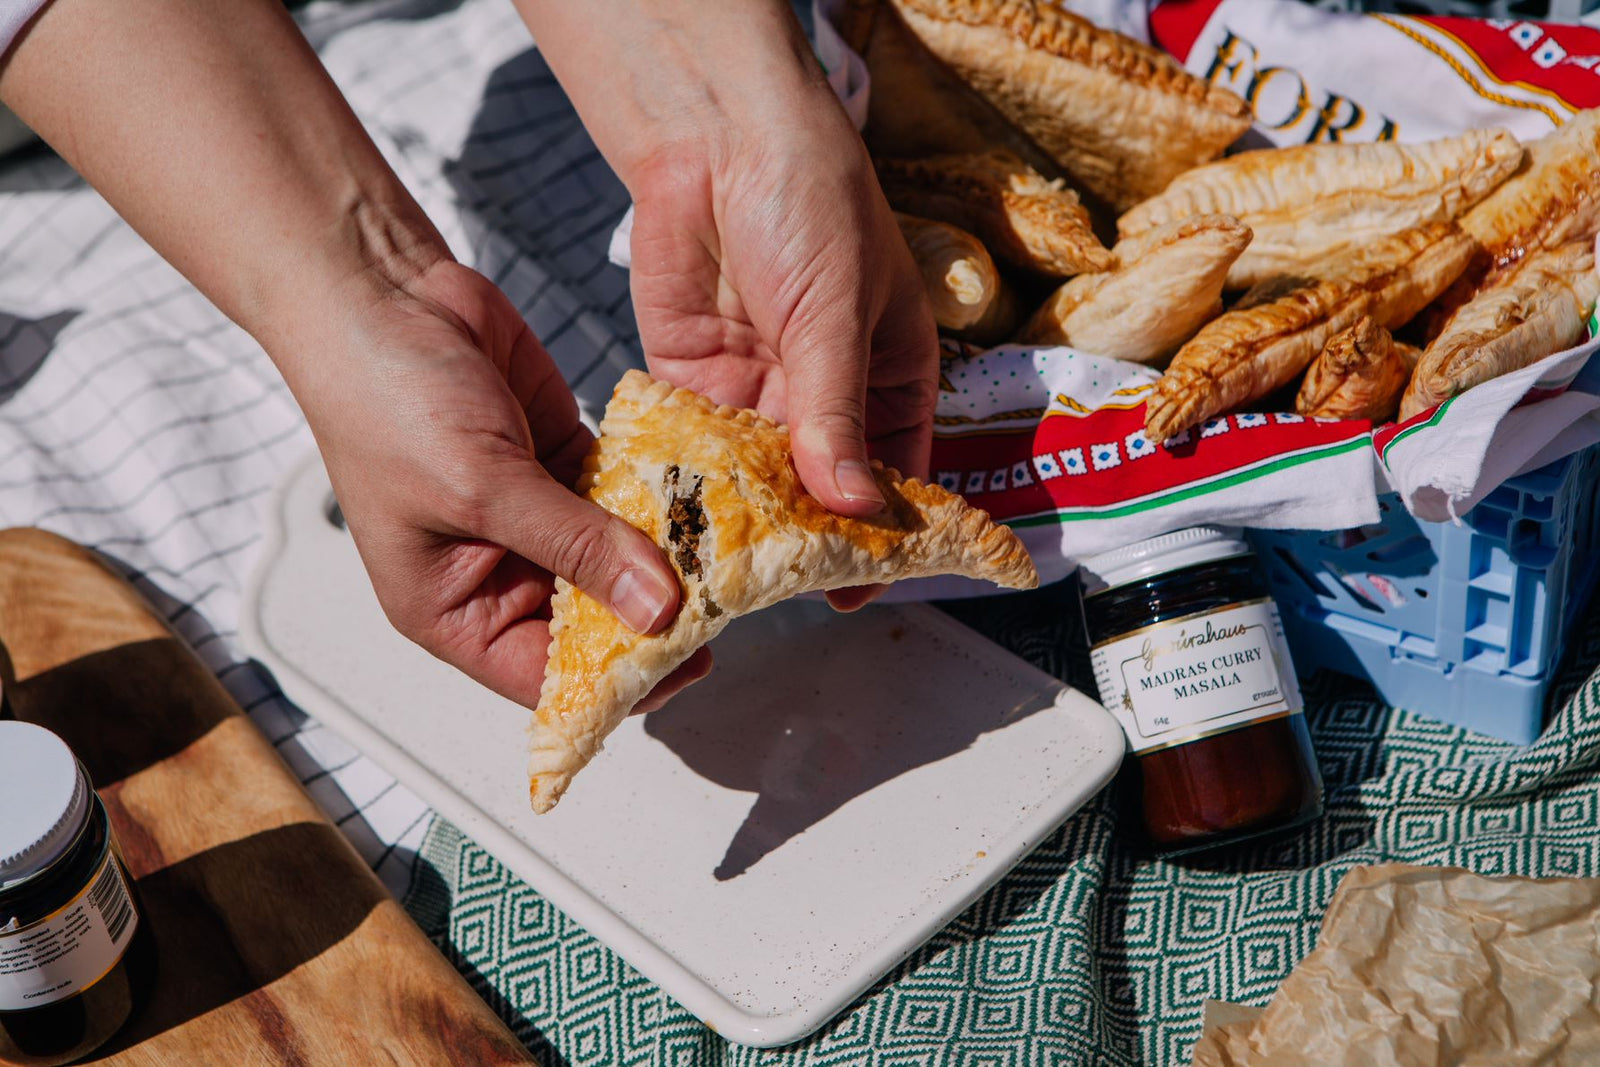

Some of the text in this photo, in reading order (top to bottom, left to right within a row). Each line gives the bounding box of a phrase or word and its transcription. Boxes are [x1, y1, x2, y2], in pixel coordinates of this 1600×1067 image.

[1140, 663, 1208, 691] MADRAS
[1212, 647, 1263, 671] CURRY
[1174, 672, 1242, 700] MASALA
[1252, 687, 1279, 701] ground
[1154, 716, 1170, 726] 64g
